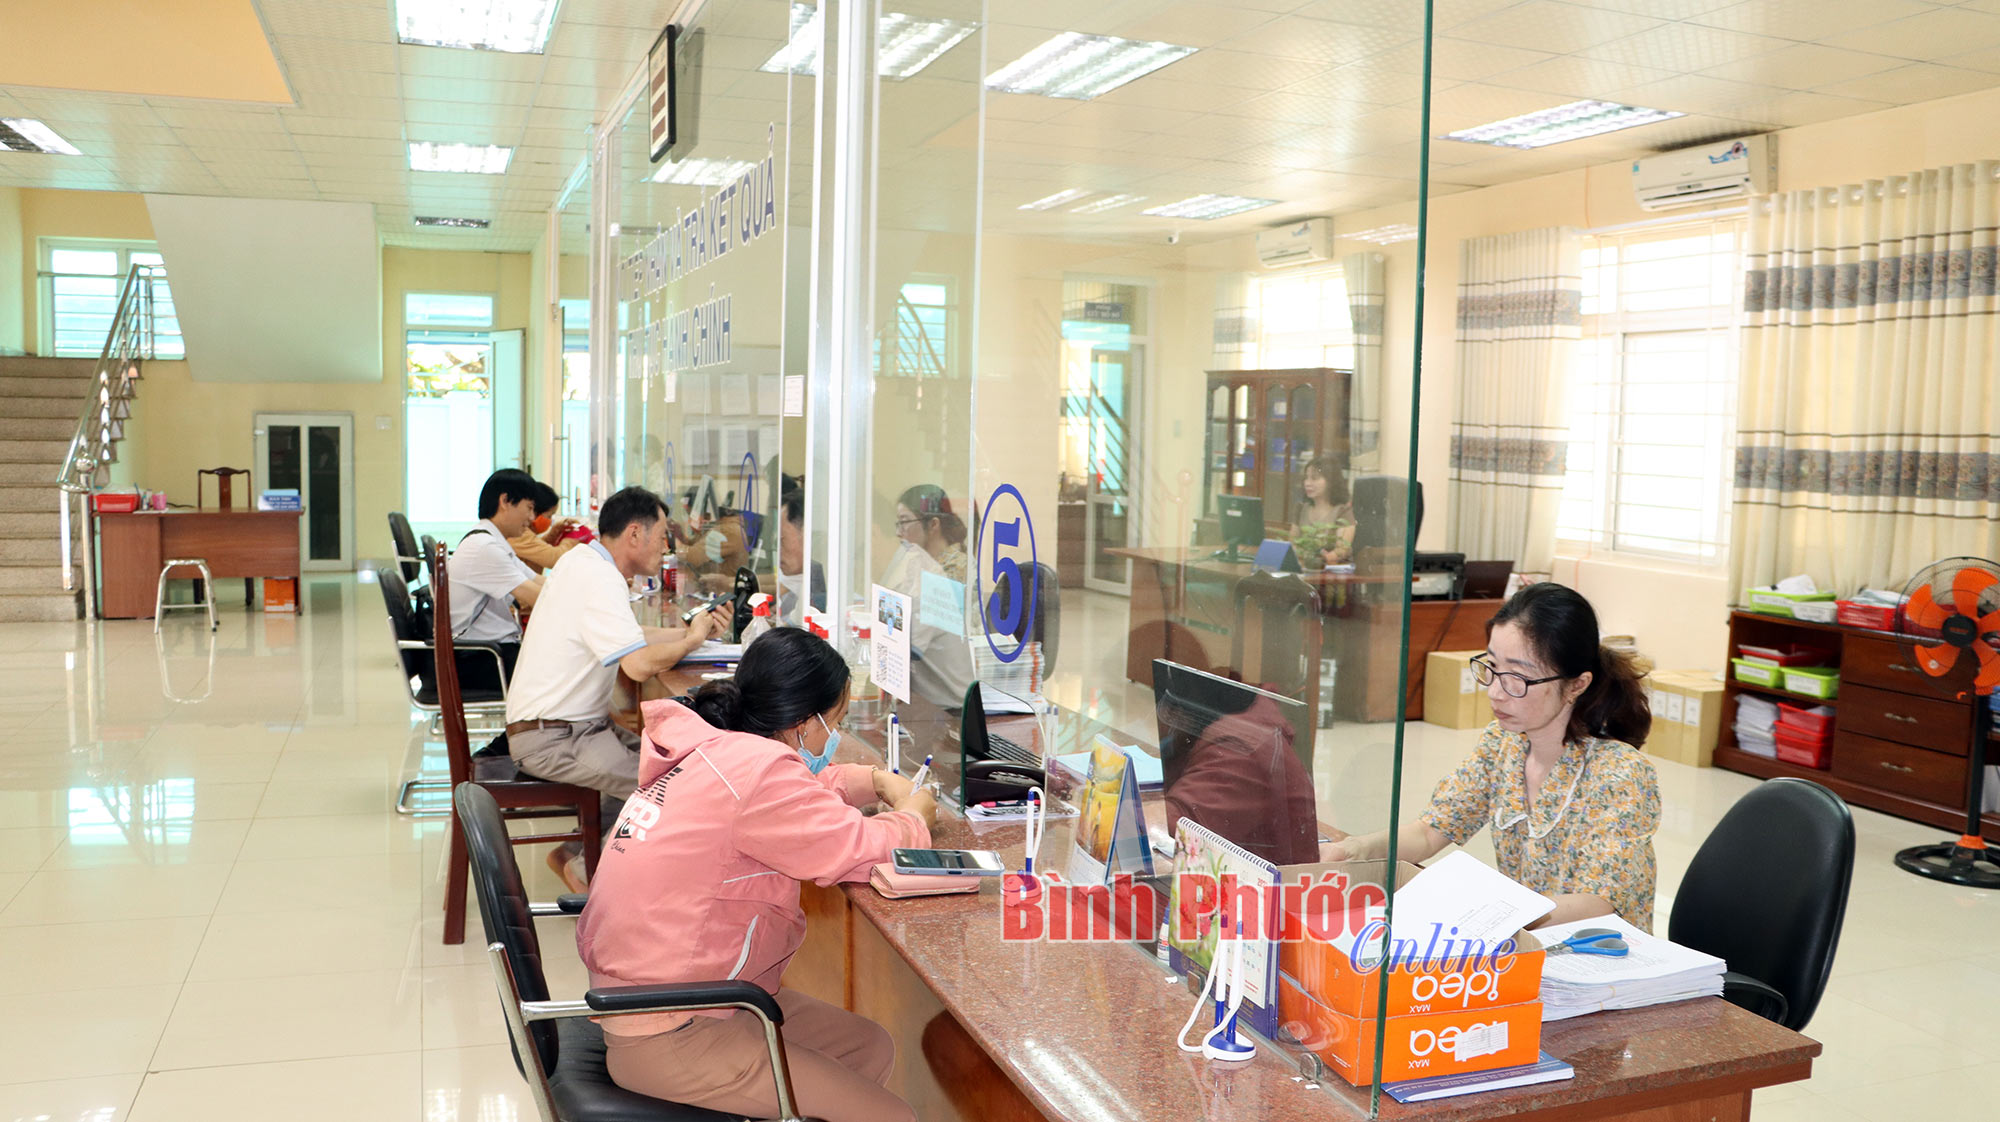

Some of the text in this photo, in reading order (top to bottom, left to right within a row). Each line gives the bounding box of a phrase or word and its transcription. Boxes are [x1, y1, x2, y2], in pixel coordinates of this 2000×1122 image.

[740, 121, 776, 246] QUẢ
[692, 282, 732, 370] CHÍNH
[990, 517, 1023, 636] 5
[1409, 1003, 1431, 1014] MAX
[1411, 969, 1500, 1008] idea
[1408, 1058, 1430, 1069] MAX
